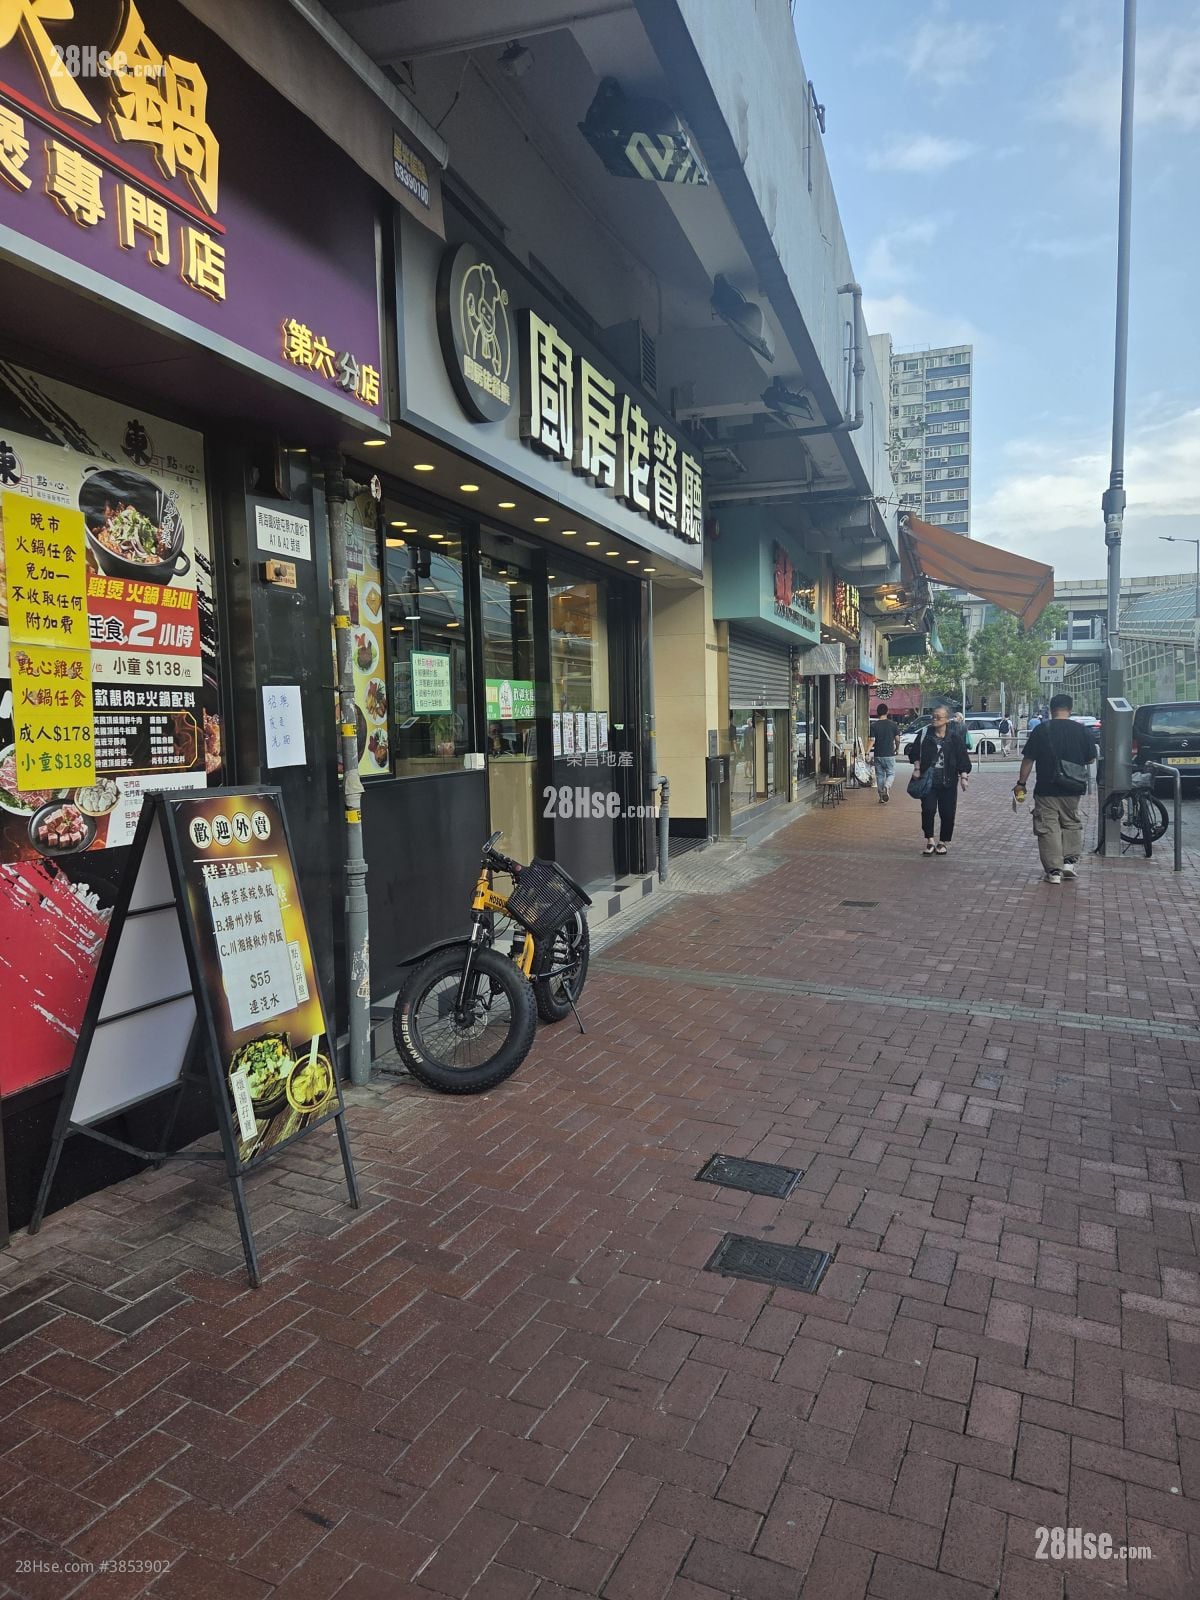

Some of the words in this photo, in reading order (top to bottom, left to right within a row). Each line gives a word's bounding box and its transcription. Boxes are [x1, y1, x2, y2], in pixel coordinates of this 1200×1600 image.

[283, 318, 380, 405] 第六分店
[527, 309, 702, 545] 廚房佬餐廳
[30, 513, 60, 533] 晚市
[16, 536, 76, 562] 火鍋任食
[26, 562, 70, 580] 免加一
[12, 586, 83, 611] 不收取任何
[87, 577, 124, 600] 雞煲
[126, 584, 160, 605] 火鍋
[161, 588, 193, 610] 點心
[26, 612, 73, 634] 附加費
[16, 657, 88, 681] 點心雞煲
[113, 657, 141, 676] 小童
[21, 687, 87, 708] 火鍋任食
[20, 722, 92, 744] 成人$178
[21, 751, 92, 772] 小童$138
[194, 815, 269, 844] 歡迎外賣
[249, 970, 271, 989] $55
[249, 993, 281, 1015] 連汽水
